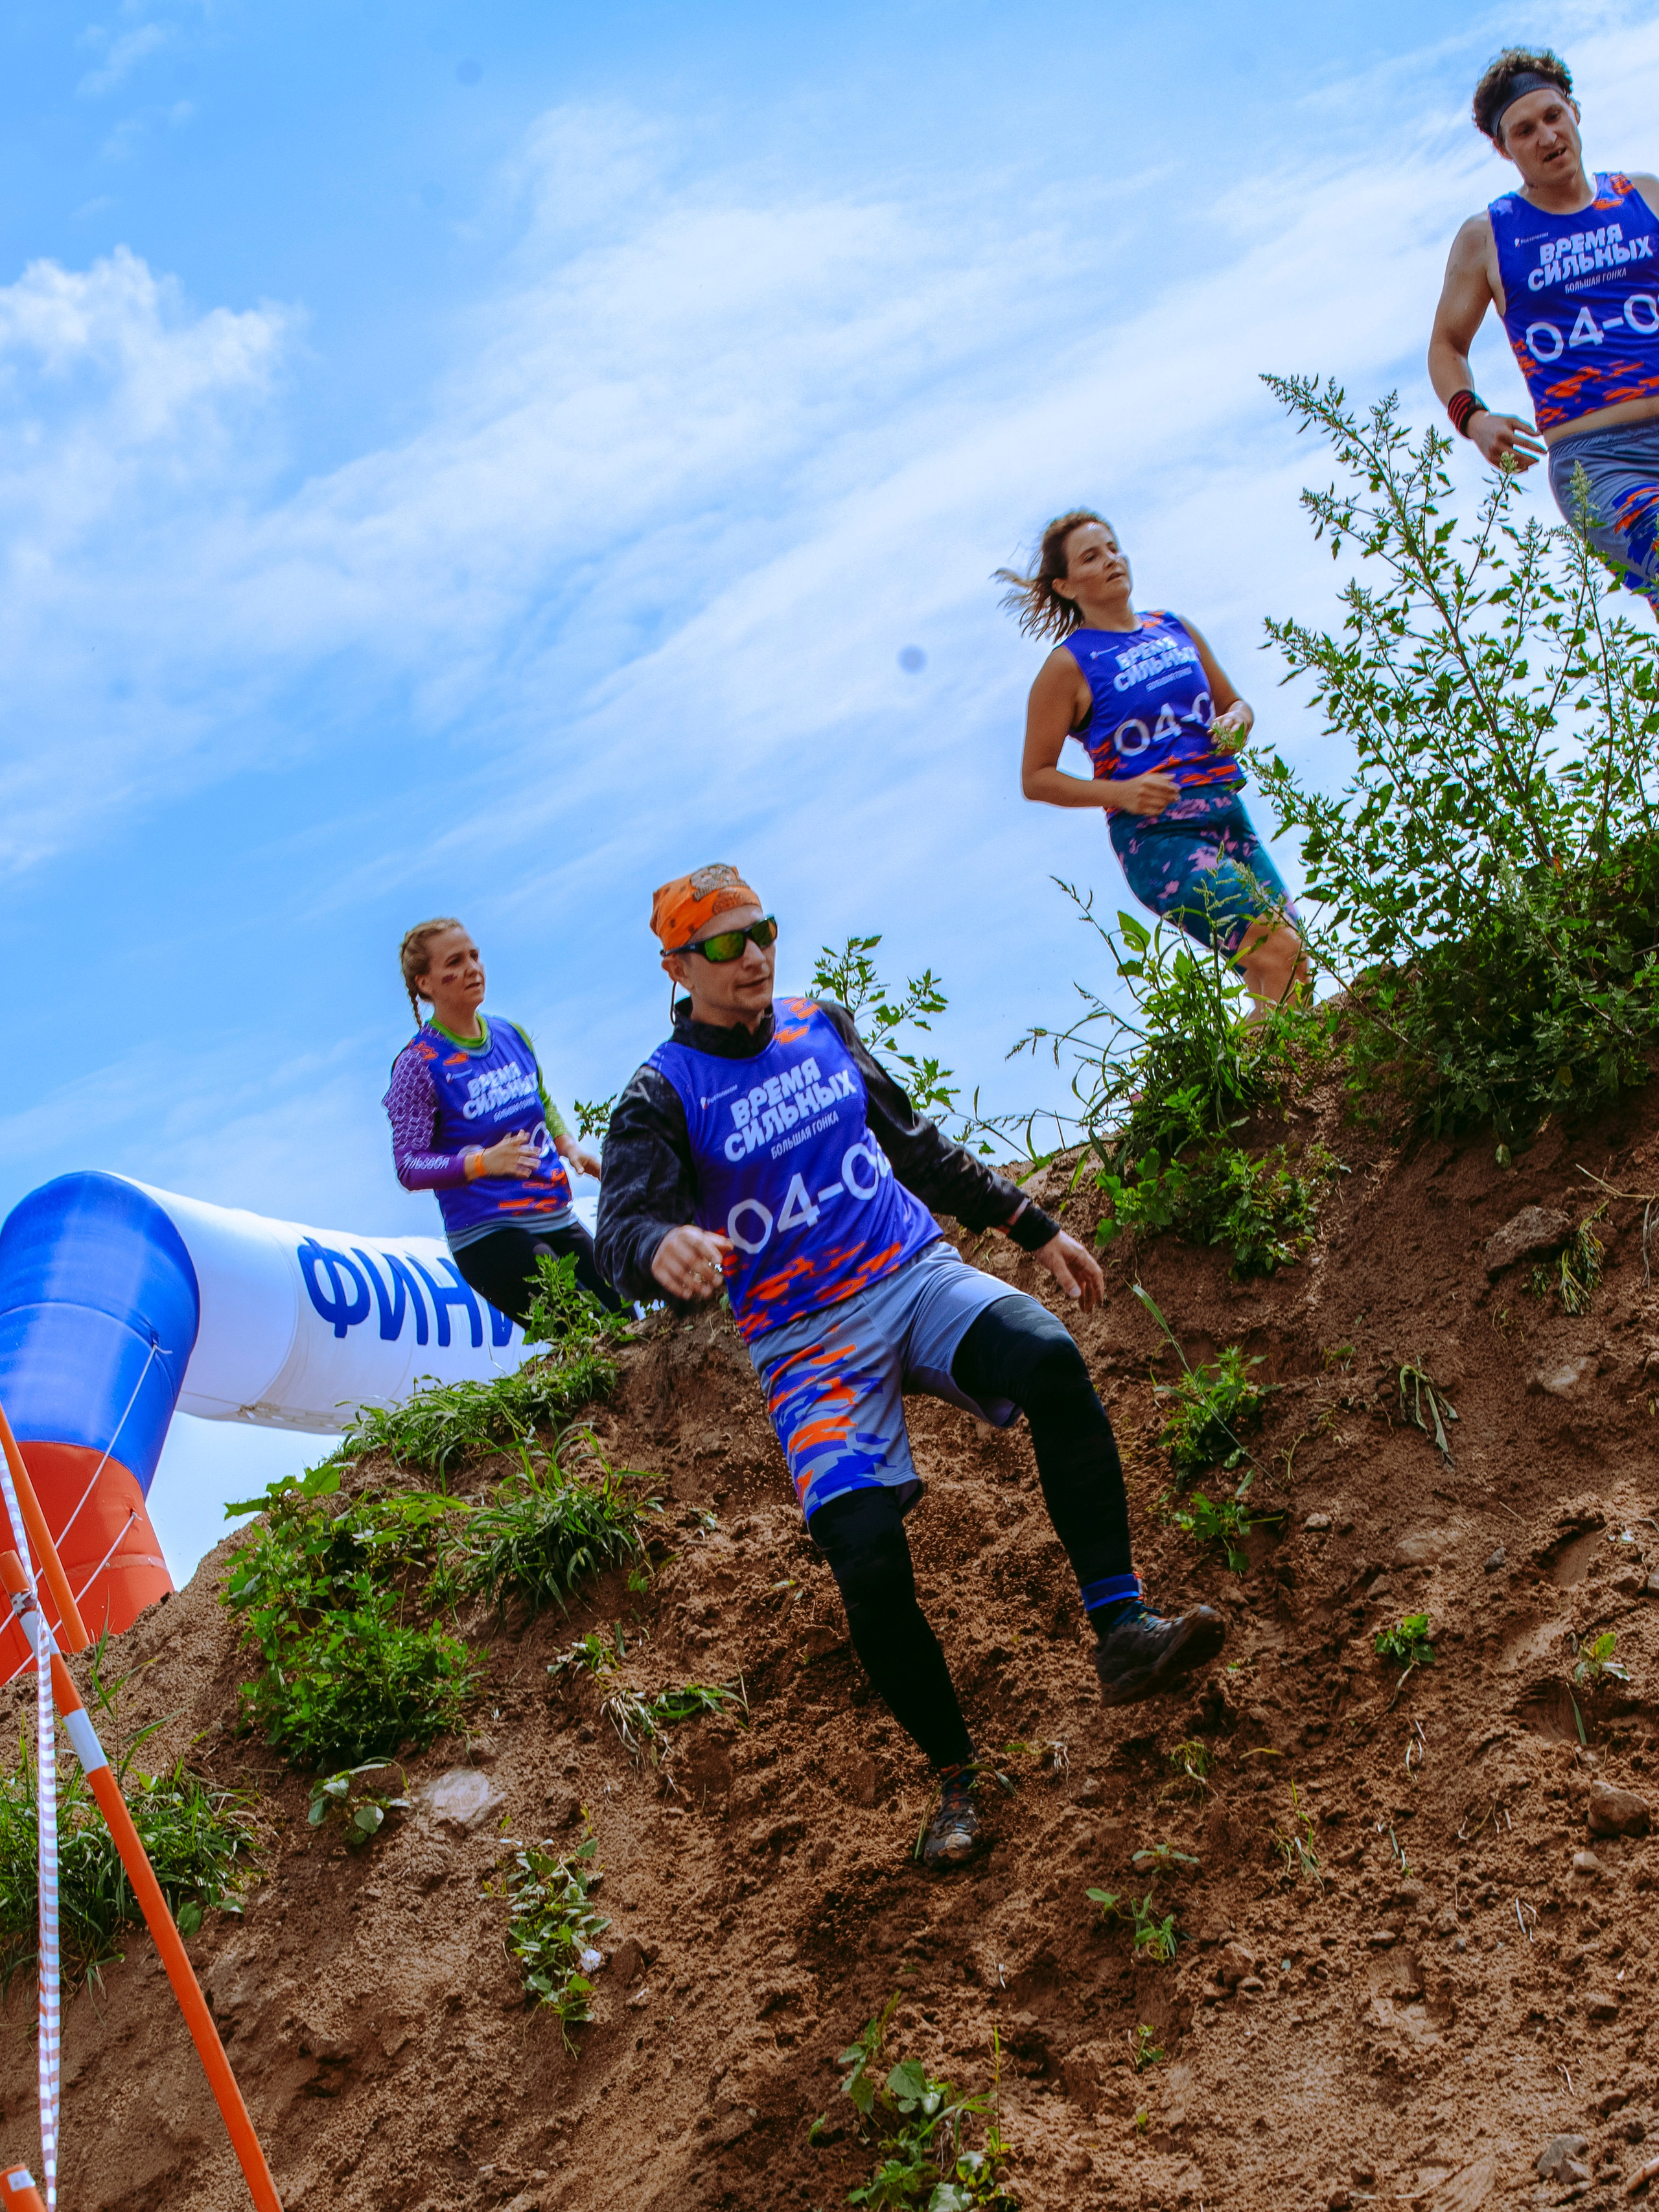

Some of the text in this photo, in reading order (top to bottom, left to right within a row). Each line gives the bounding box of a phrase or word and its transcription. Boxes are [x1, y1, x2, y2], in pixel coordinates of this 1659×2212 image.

[1527, 235, 1653, 292] СИЛЬНЫХ
[1540, 223, 1623, 267] ВРЕМЯ
[1564, 267, 1627, 294] БОЛЬШАЯ ГОНКА
[1526, 294, 1659, 363] 04-0
[724, 1069, 857, 1162] СИЛЬНЫХ
[730, 1056, 821, 1130] ВРЕМЯ
[771, 1110, 839, 1160] БОЛЬШАЯ ГОНКА
[726, 1141, 891, 1254] 04-0
